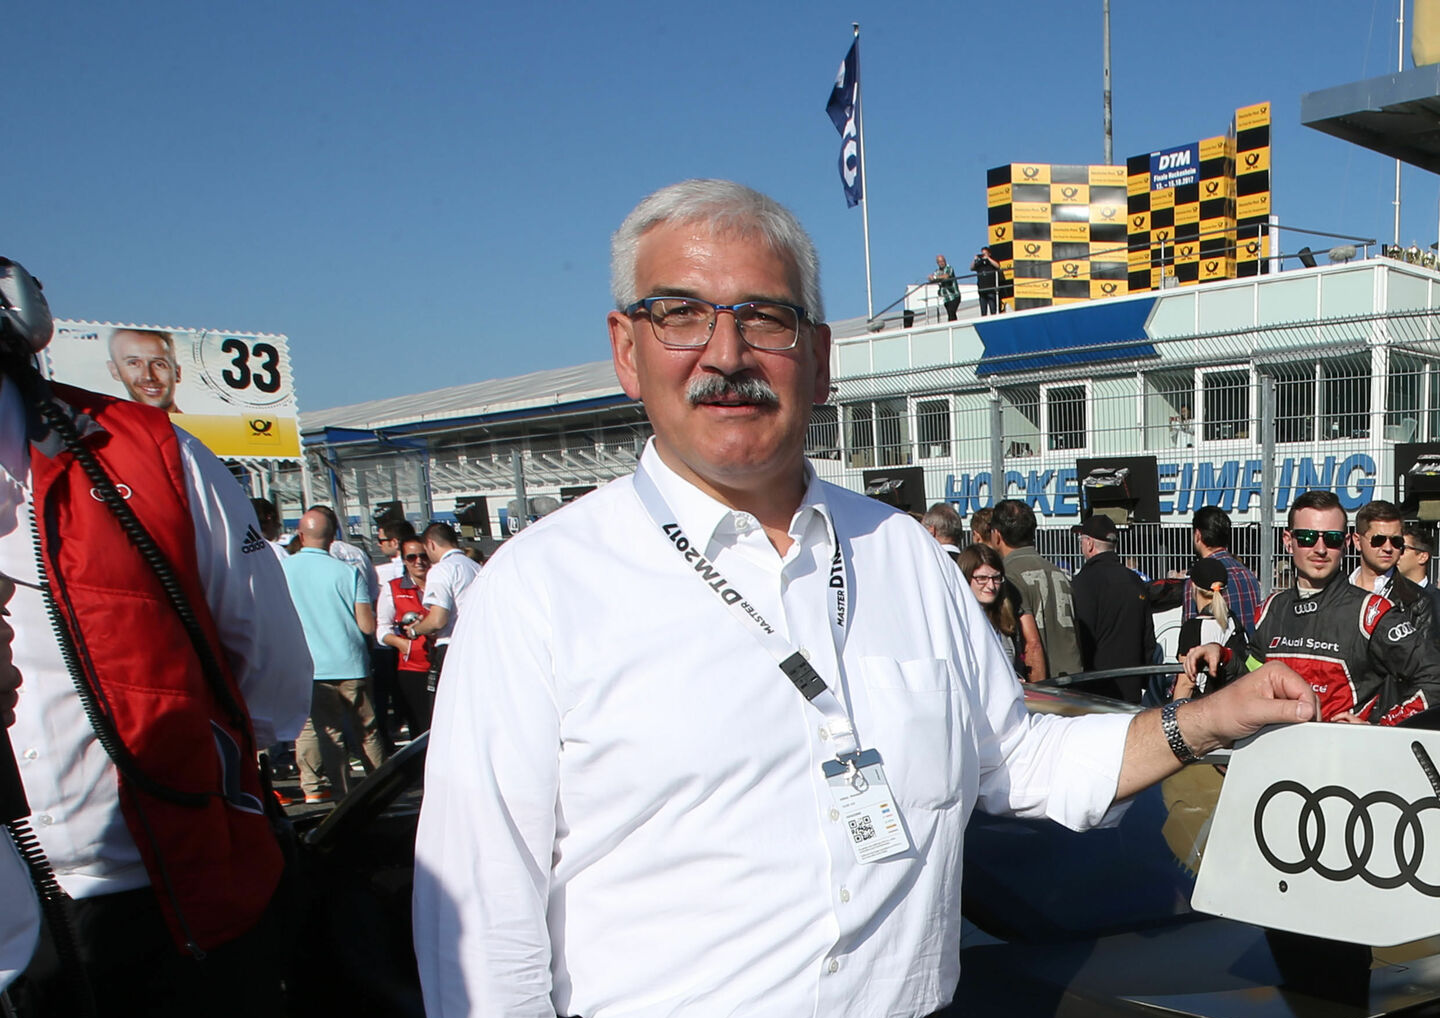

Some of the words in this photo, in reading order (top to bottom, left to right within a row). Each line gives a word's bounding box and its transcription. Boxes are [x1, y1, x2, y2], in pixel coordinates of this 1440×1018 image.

[1158, 150, 1191, 171] DTM
[221, 338, 281, 394] 33
[662, 523, 702, 563] 2017
[694, 558, 743, 606] DTM
[740, 601, 775, 635] MASTER
[836, 590, 846, 628] MASTER
[1279, 636, 1304, 648] Audi
[1305, 638, 1340, 652] Sport
